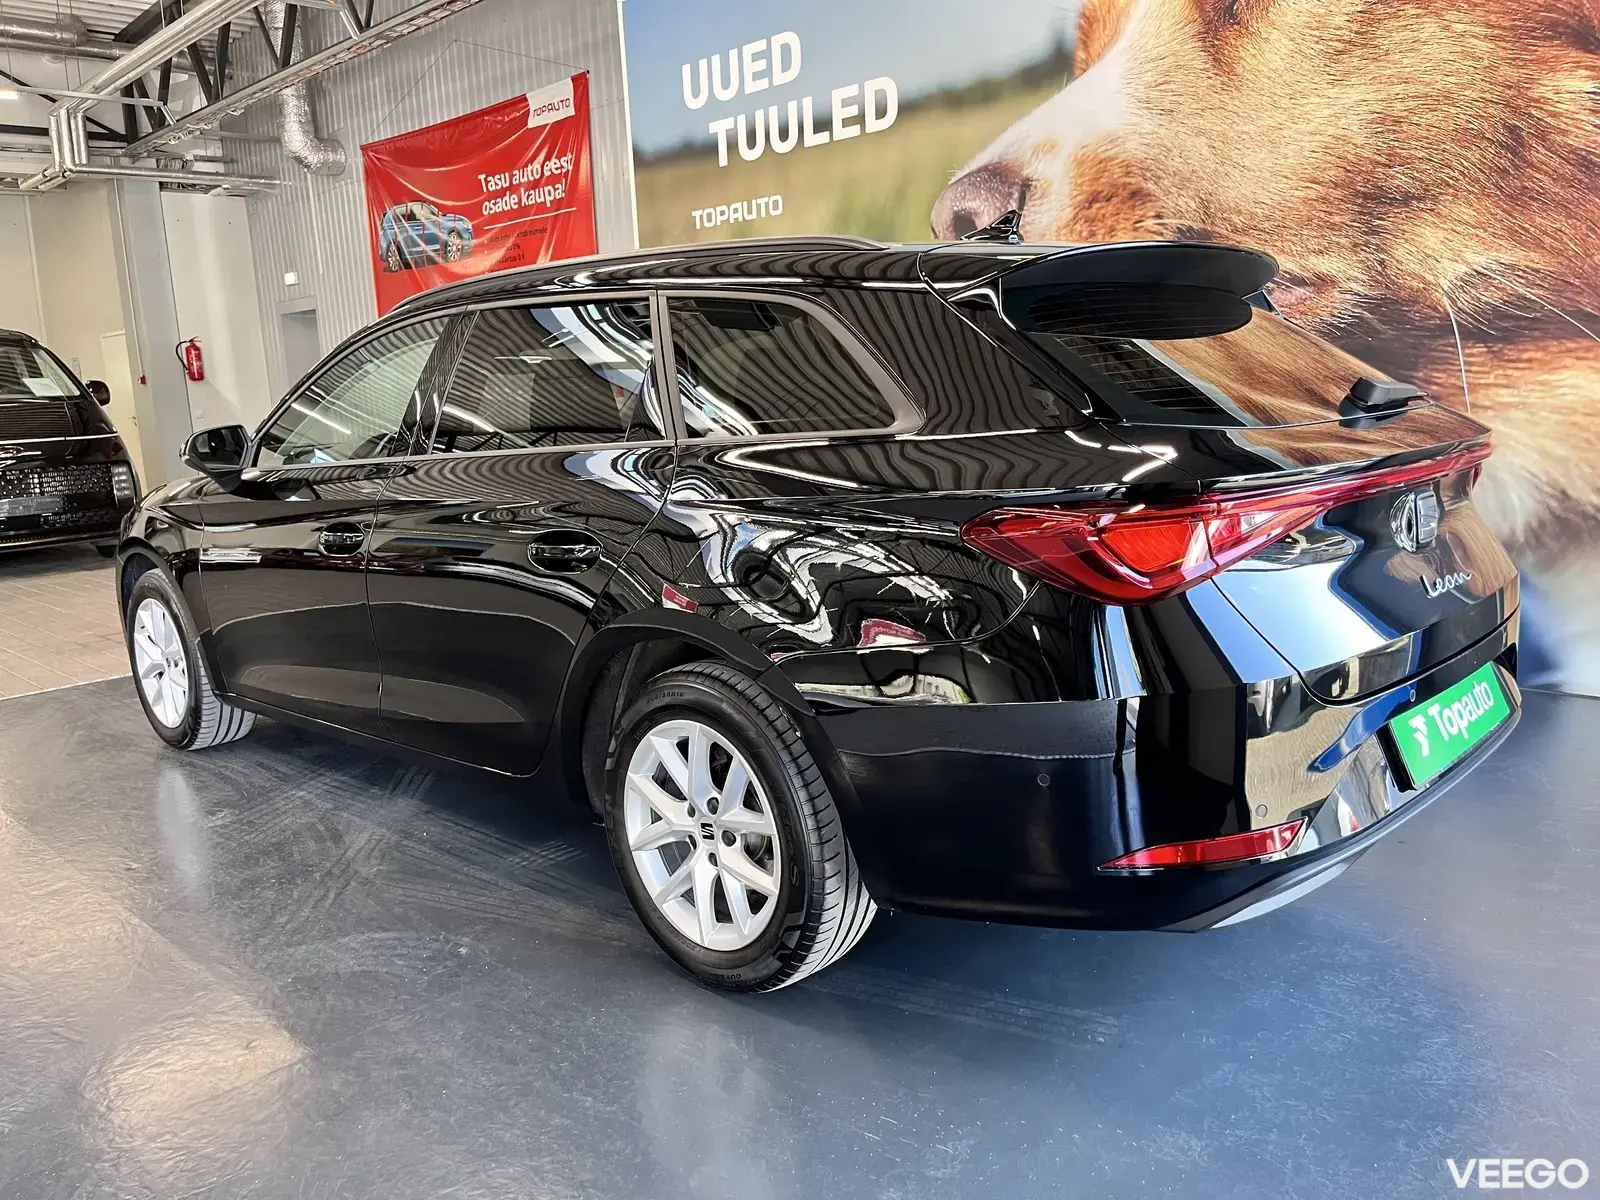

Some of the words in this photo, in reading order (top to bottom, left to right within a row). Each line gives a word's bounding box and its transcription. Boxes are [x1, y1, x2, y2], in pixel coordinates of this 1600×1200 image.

[682, 31, 802, 110] UUED
[533, 98, 570, 118] TOPAUTO
[708, 76, 899, 168] TUULED
[478, 172, 510, 193] Tasu
[512, 163, 542, 185] auto
[543, 153, 573, 176] eest
[482, 190, 519, 216] osade
[520, 178, 566, 208] kaupa!
[692, 194, 784, 230] TOPAUTO
[1421, 571, 1472, 598] Leon
[1427, 680, 1495, 742] Topauto
